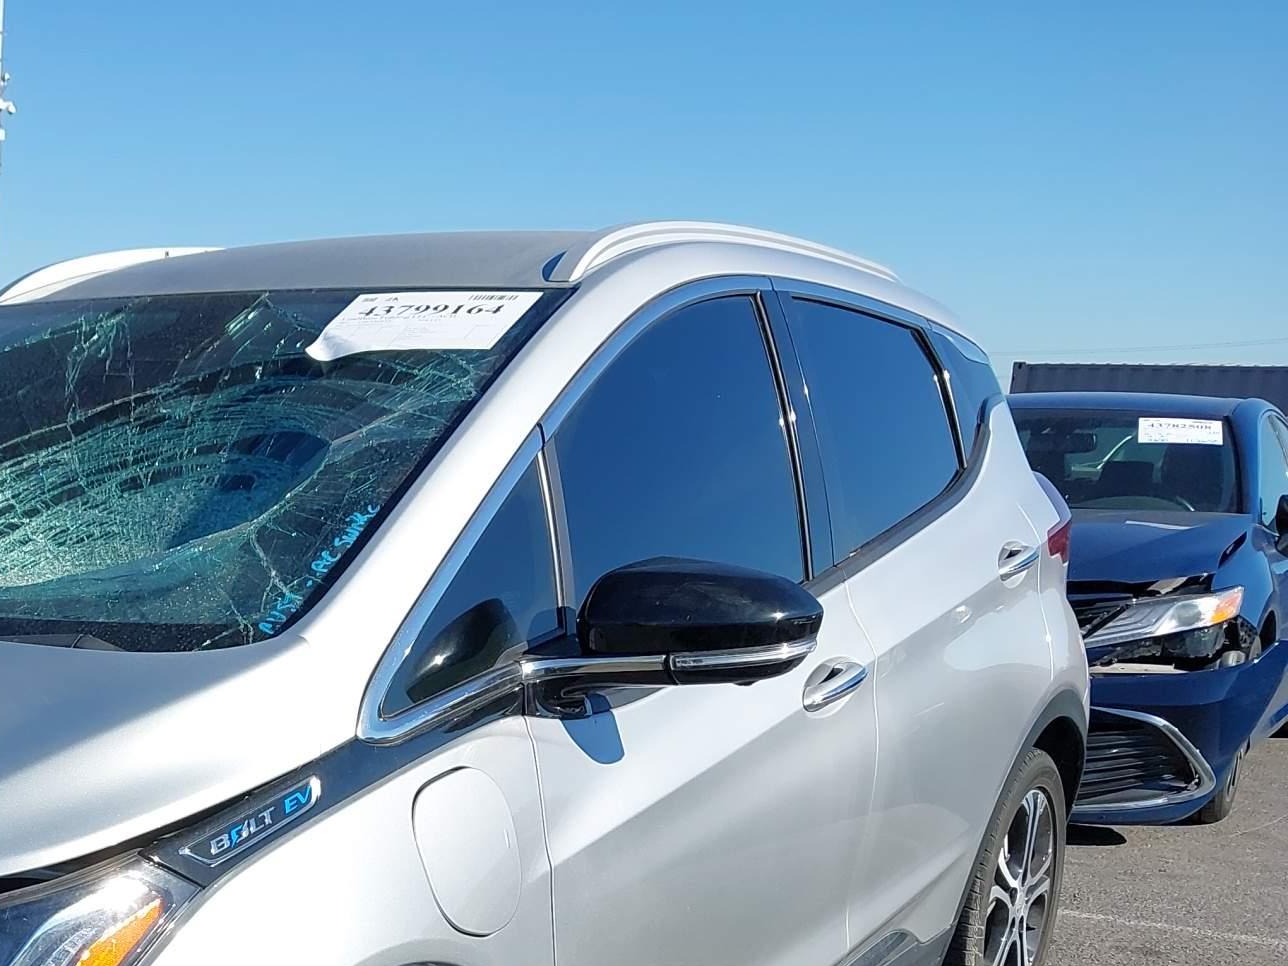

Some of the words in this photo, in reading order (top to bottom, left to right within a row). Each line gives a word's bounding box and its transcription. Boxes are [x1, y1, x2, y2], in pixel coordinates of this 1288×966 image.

[357, 302, 506, 318] 43799164
[209, 806, 276, 857] BOLT
[283, 784, 312, 815] EV
